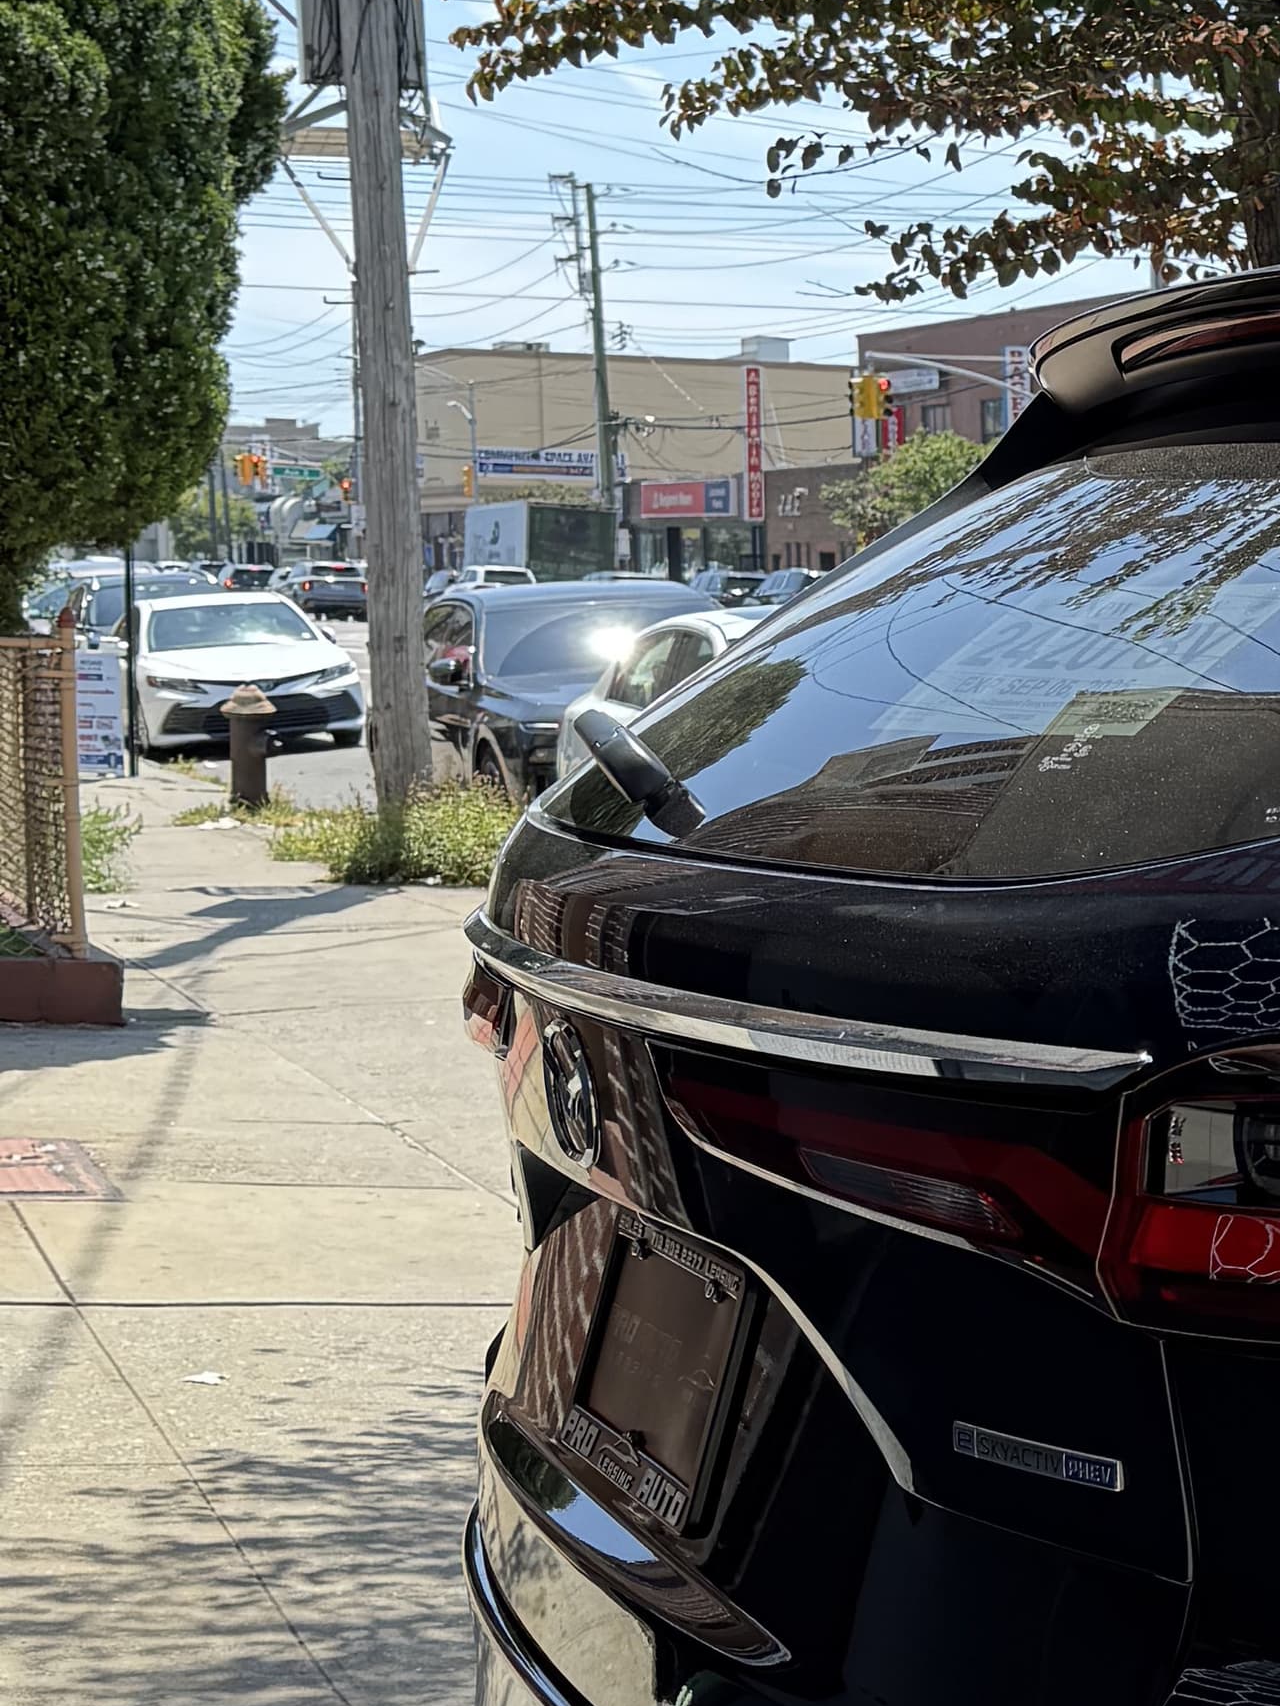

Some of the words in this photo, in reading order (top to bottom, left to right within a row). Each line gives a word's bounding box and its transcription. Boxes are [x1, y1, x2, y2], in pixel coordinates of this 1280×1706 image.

[749, 472, 762, 516] Moore
[705, 1257, 741, 1292] LEASING
[560, 1409, 599, 1457] PRO
[597, 1454, 633, 1489] LEASING
[636, 1467, 687, 1526] AUTO
[979, 1436, 1062, 1474] SKYACTIV
[1067, 1459, 1112, 1484] PHEV
